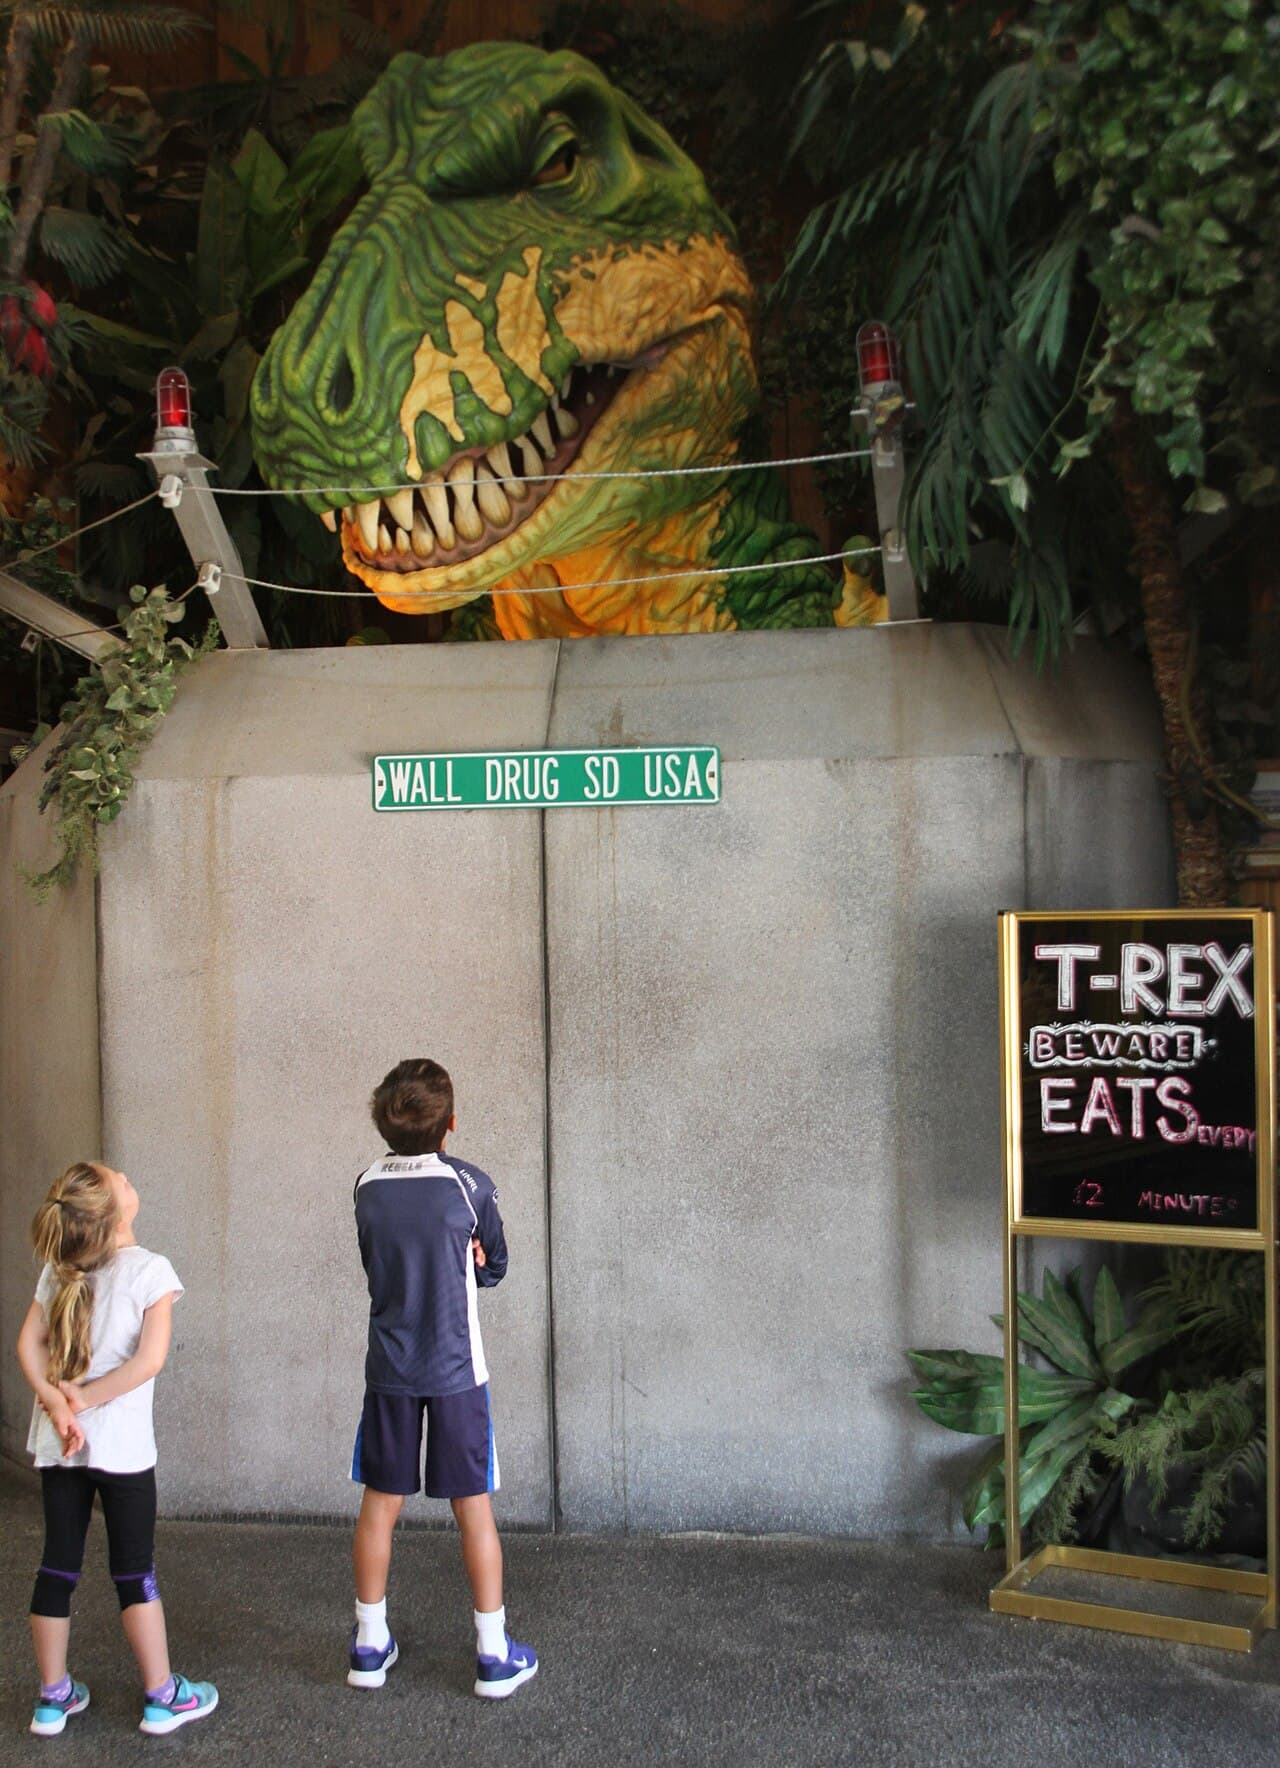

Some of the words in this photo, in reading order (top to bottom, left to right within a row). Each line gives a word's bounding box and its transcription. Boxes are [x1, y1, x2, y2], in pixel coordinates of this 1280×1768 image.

[389, 760, 462, 803] WALL
[485, 757, 559, 801] DRUG
[583, 755, 620, 799] SD
[643, 754, 703, 797] USA
[1035, 943, 1256, 1018] T-REX
[1036, 1033, 1192, 1059] BEWARE
[1040, 1076, 1199, 1143] EATS
